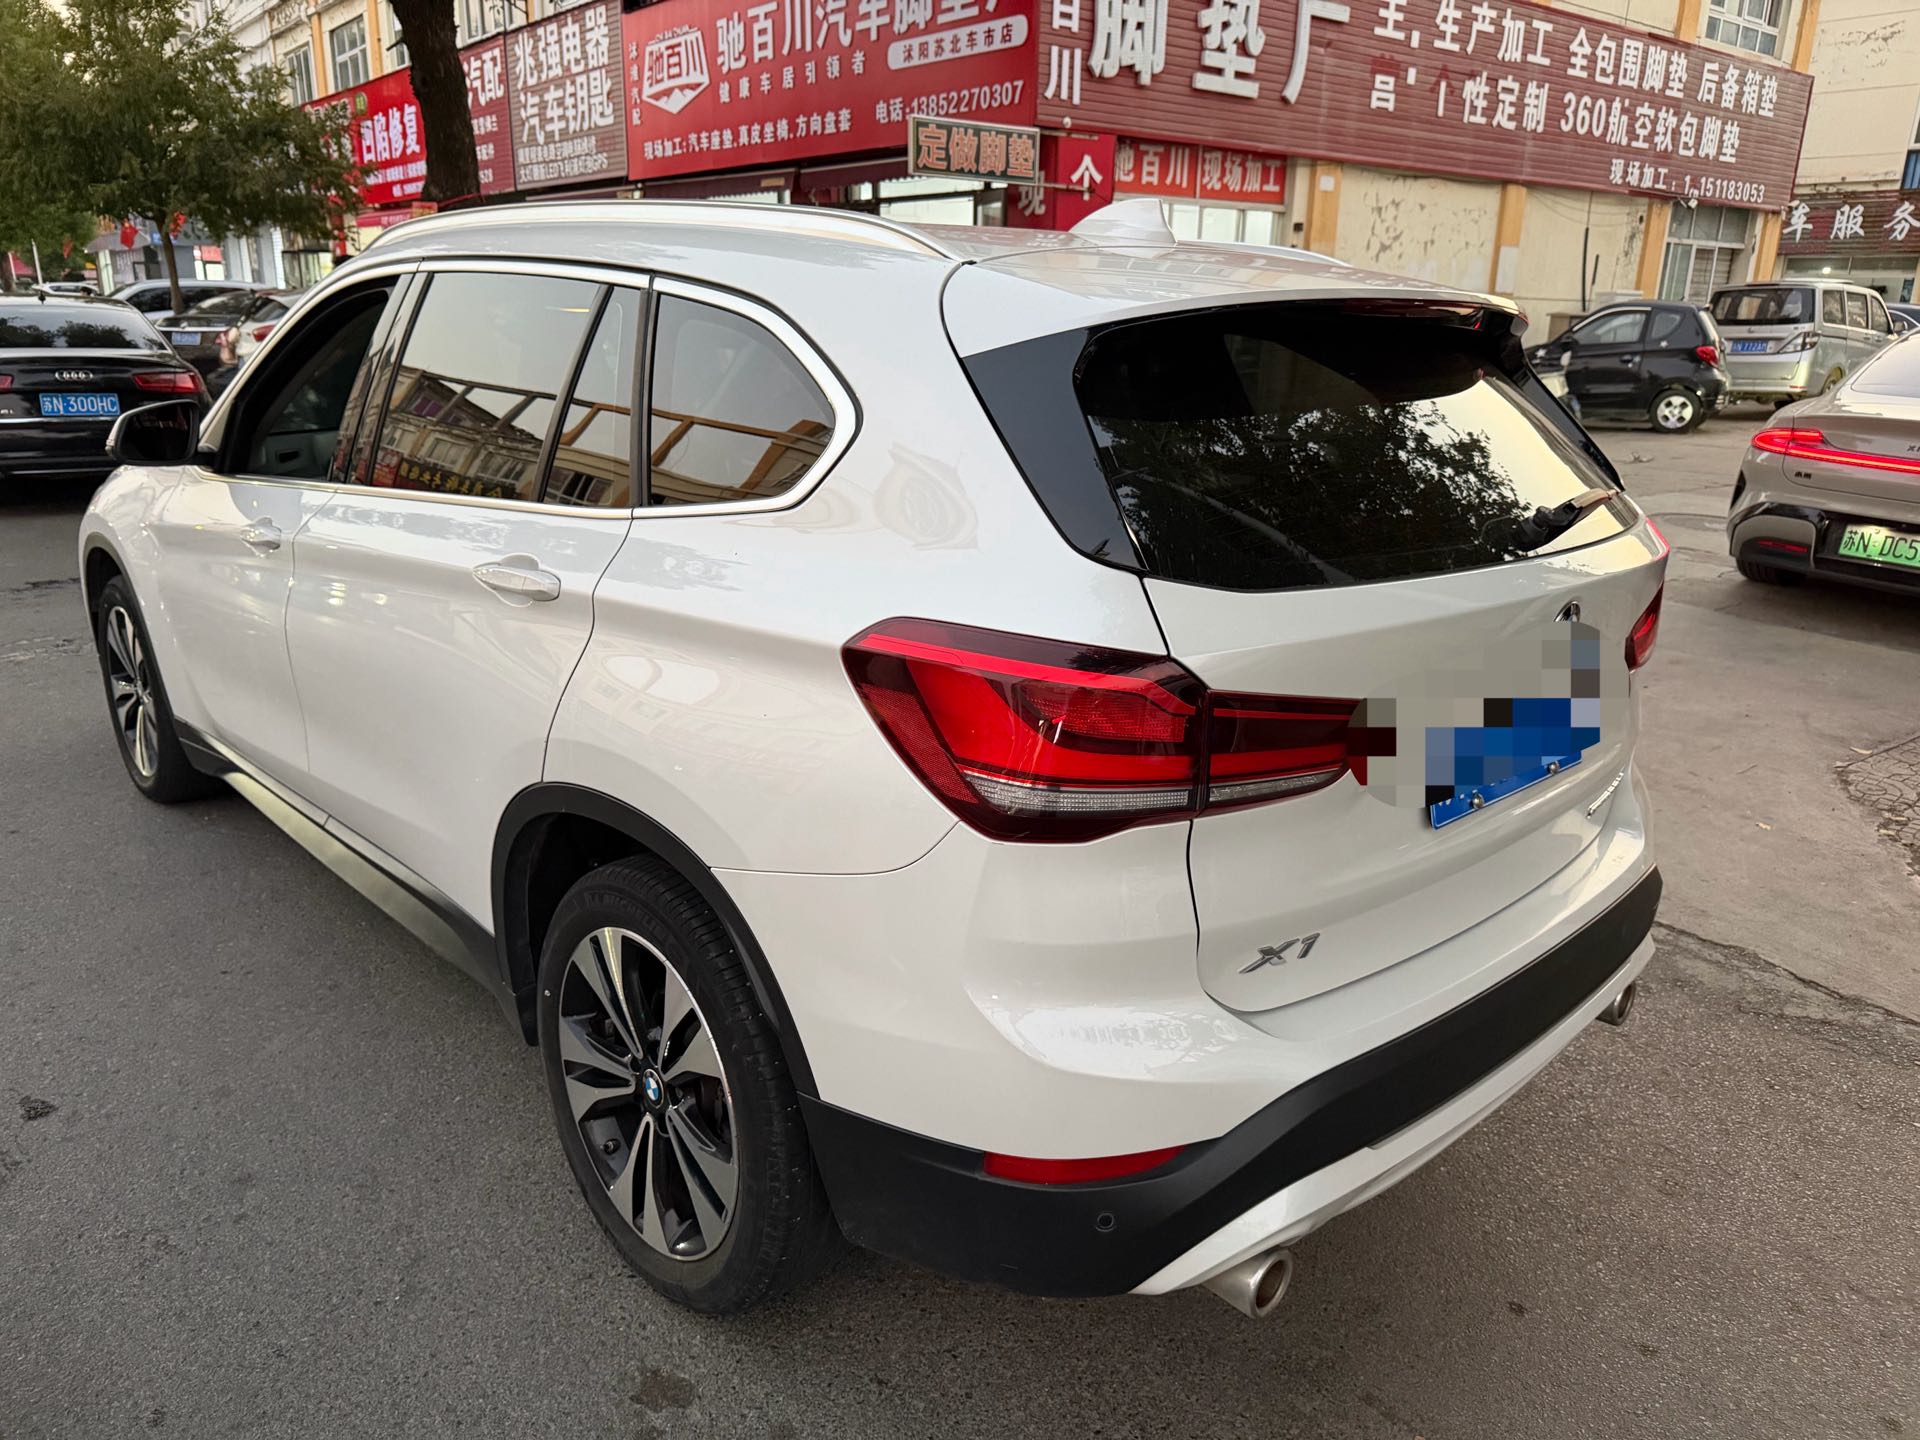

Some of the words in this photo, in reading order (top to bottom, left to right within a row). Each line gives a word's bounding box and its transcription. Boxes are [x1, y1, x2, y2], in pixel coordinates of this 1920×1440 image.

[514, 5, 611, 91] 兆强电器
[1433, 0, 1554, 67] 生产加工
[1566, 26, 1688, 99] 全包围脚垫
[1697, 61, 1778, 118] 后备箱垫
[519, 69, 615, 146] 汽车钥匙
[917, 124, 1035, 177] 定做脚垫
[1202, 150, 1281, 193] 现场加工
[1239, 933, 1321, 974] X1
